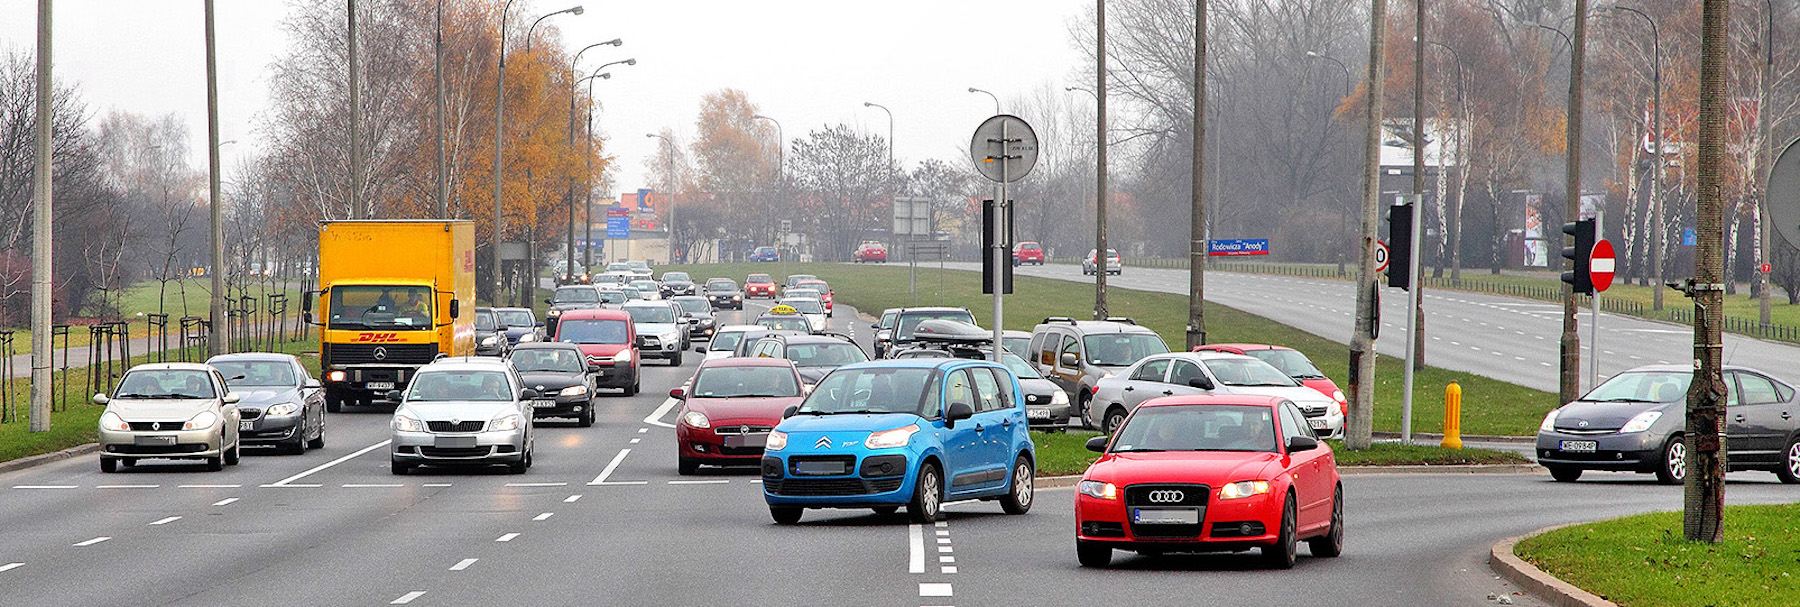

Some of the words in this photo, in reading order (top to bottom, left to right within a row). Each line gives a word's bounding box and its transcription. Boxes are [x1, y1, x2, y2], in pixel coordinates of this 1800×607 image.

[1211, 242, 1241, 250] Rodowicza
[1243, 241, 1265, 251] "Anody"
[359, 333, 399, 342] DHL
